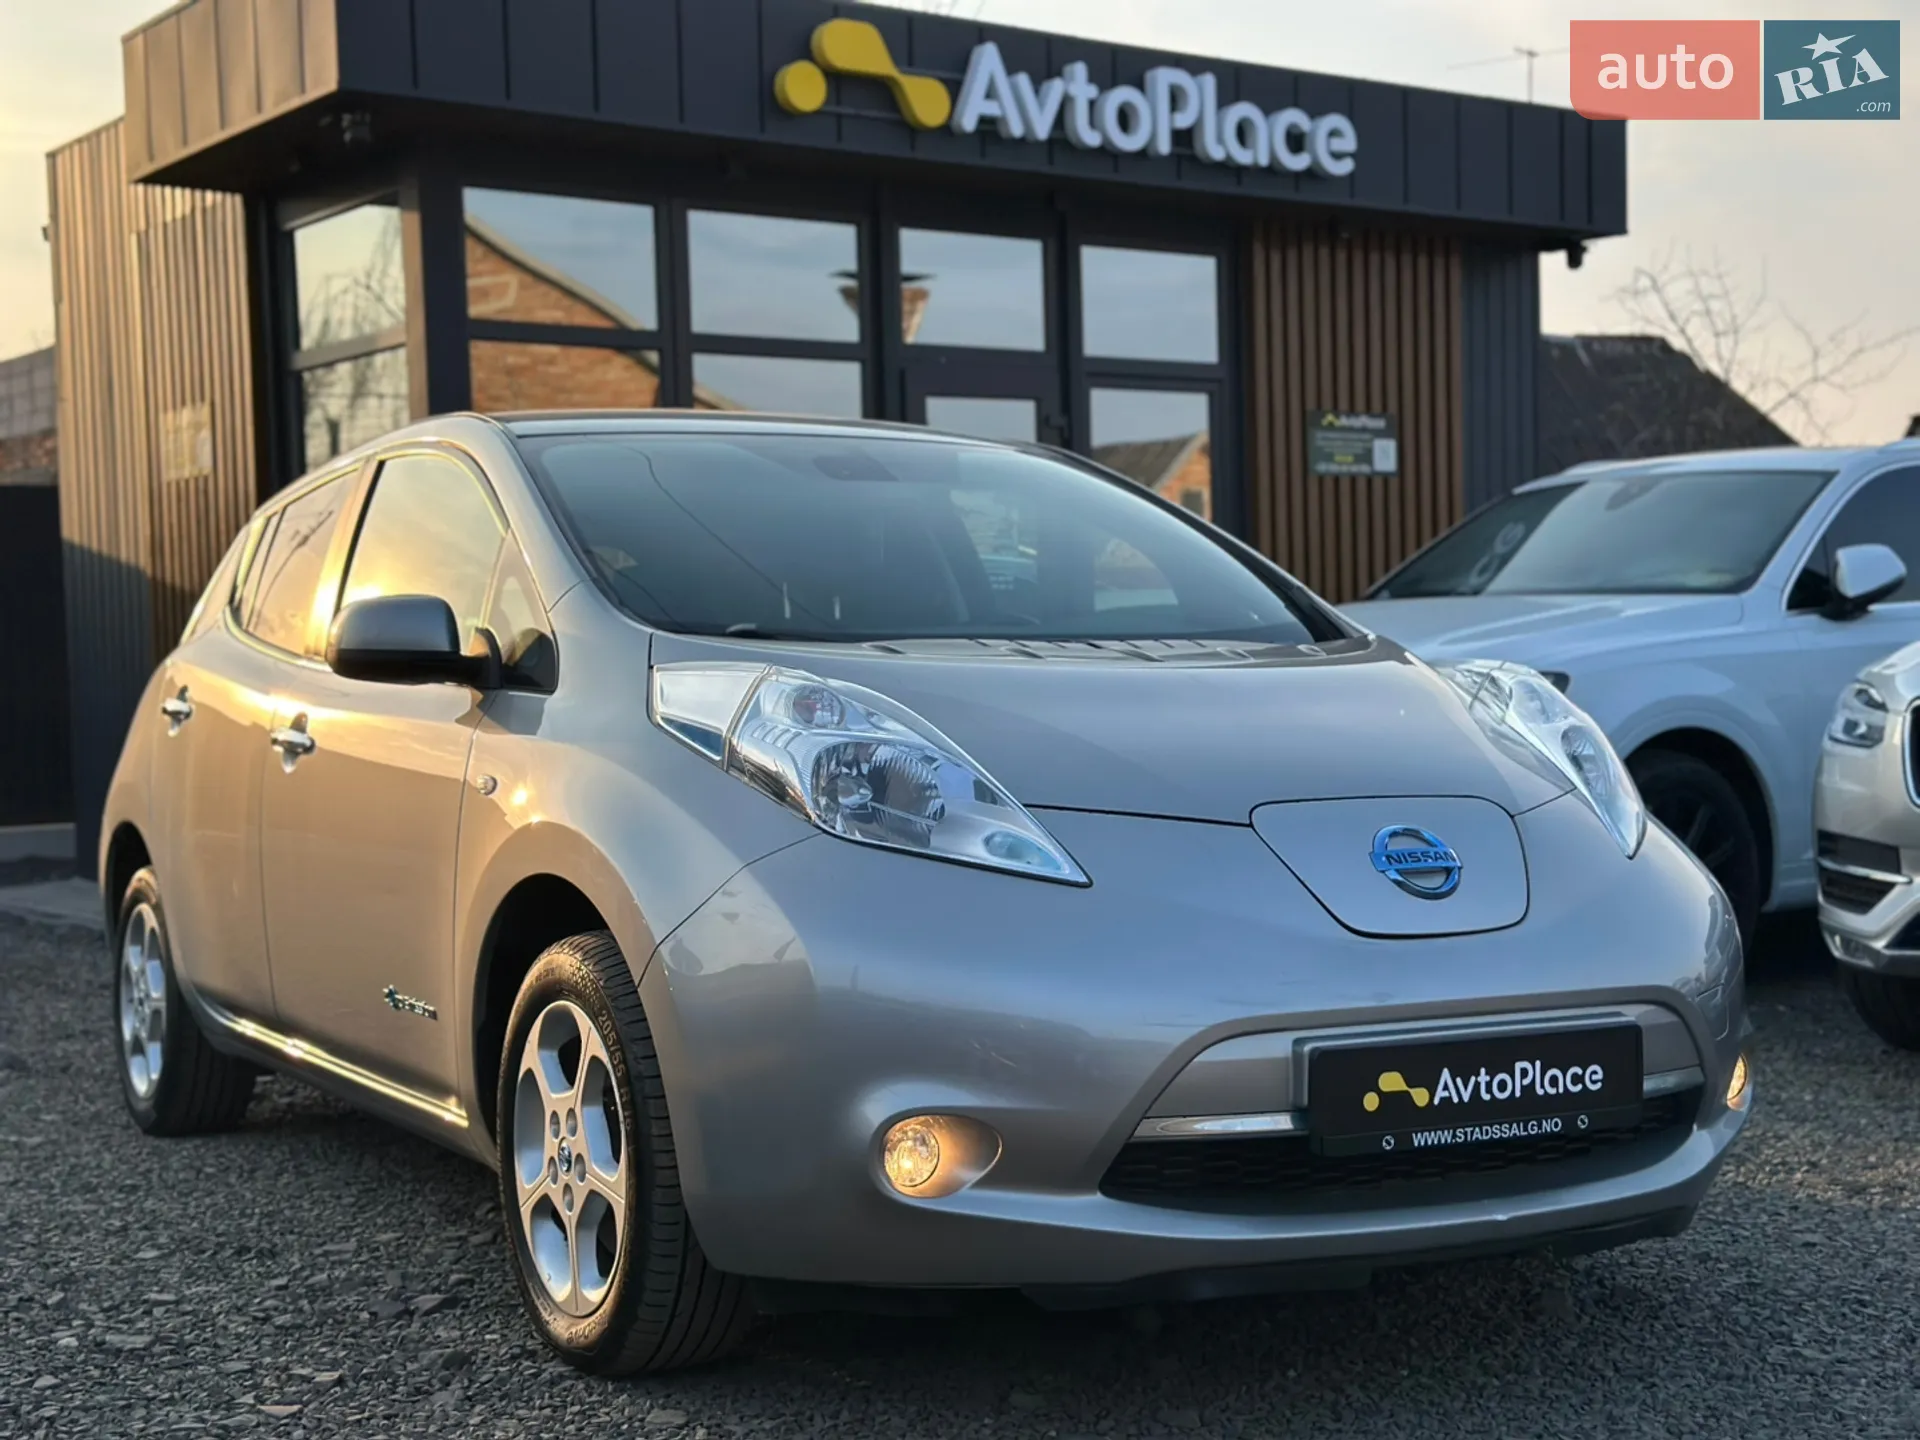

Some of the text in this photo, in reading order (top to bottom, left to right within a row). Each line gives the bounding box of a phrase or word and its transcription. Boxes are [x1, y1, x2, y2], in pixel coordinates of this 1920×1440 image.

[951, 41, 1357, 177] AvtoPlace
[1385, 850, 1457, 866] NISSAN
[597, 1010, 626, 1077] 205/55
[1433, 1060, 1604, 1106] AvtoPlace
[1412, 1118, 1562, 1147] WWW.STADSSALG.NO
